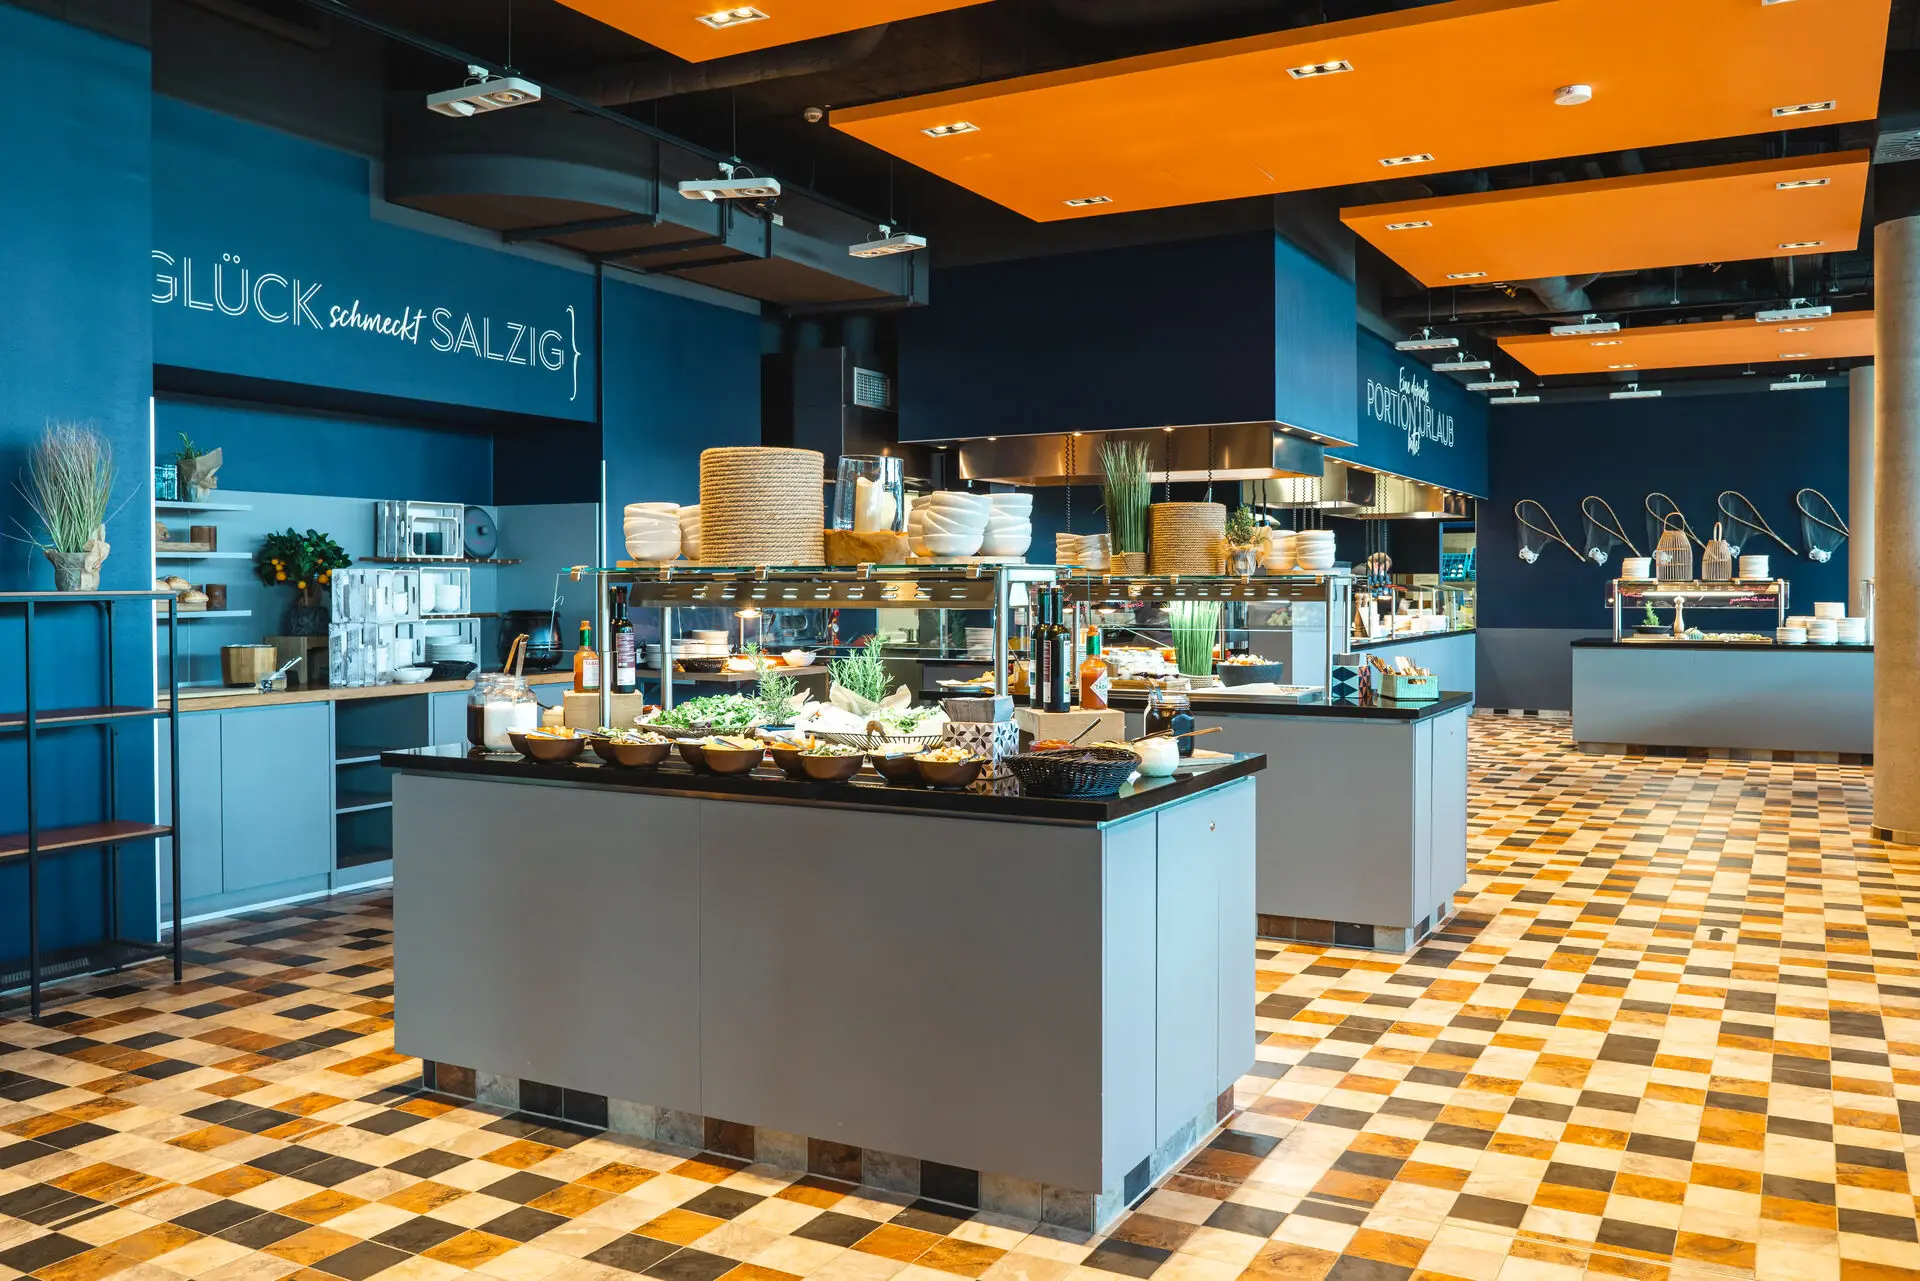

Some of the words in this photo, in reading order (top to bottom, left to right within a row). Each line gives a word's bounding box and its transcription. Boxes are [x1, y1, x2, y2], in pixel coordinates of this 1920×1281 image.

[151, 249, 324, 331] GLÜCK
[329, 299, 427, 345] schmeckt
[1367, 378, 1417, 433] PORTION
[1417, 402, 1455, 448] URLAUB
